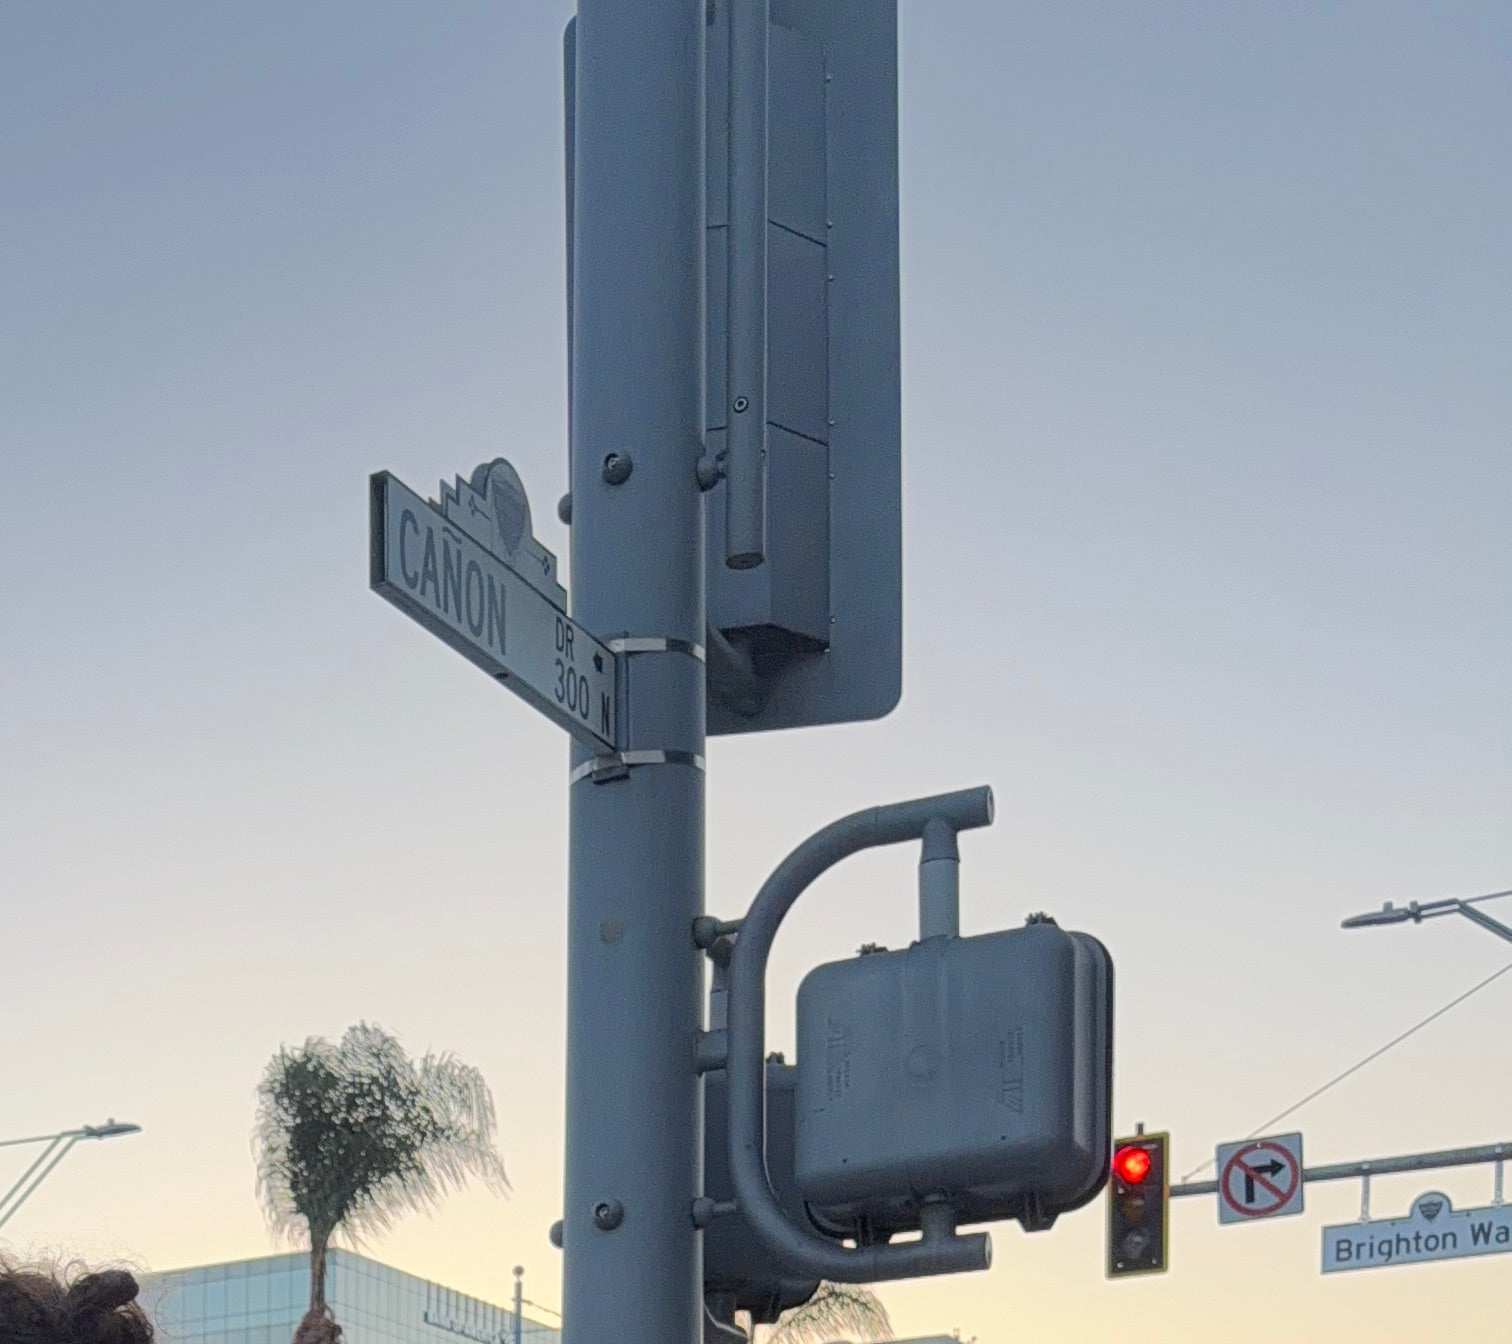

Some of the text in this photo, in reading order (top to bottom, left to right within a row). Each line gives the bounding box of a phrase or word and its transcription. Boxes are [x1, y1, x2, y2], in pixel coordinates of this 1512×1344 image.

[399, 508, 506, 656] CAÑON
[555, 617, 574, 662] DR
[554, 659, 610, 738] 300 N
[1336, 1231, 1458, 1263] Brighton
